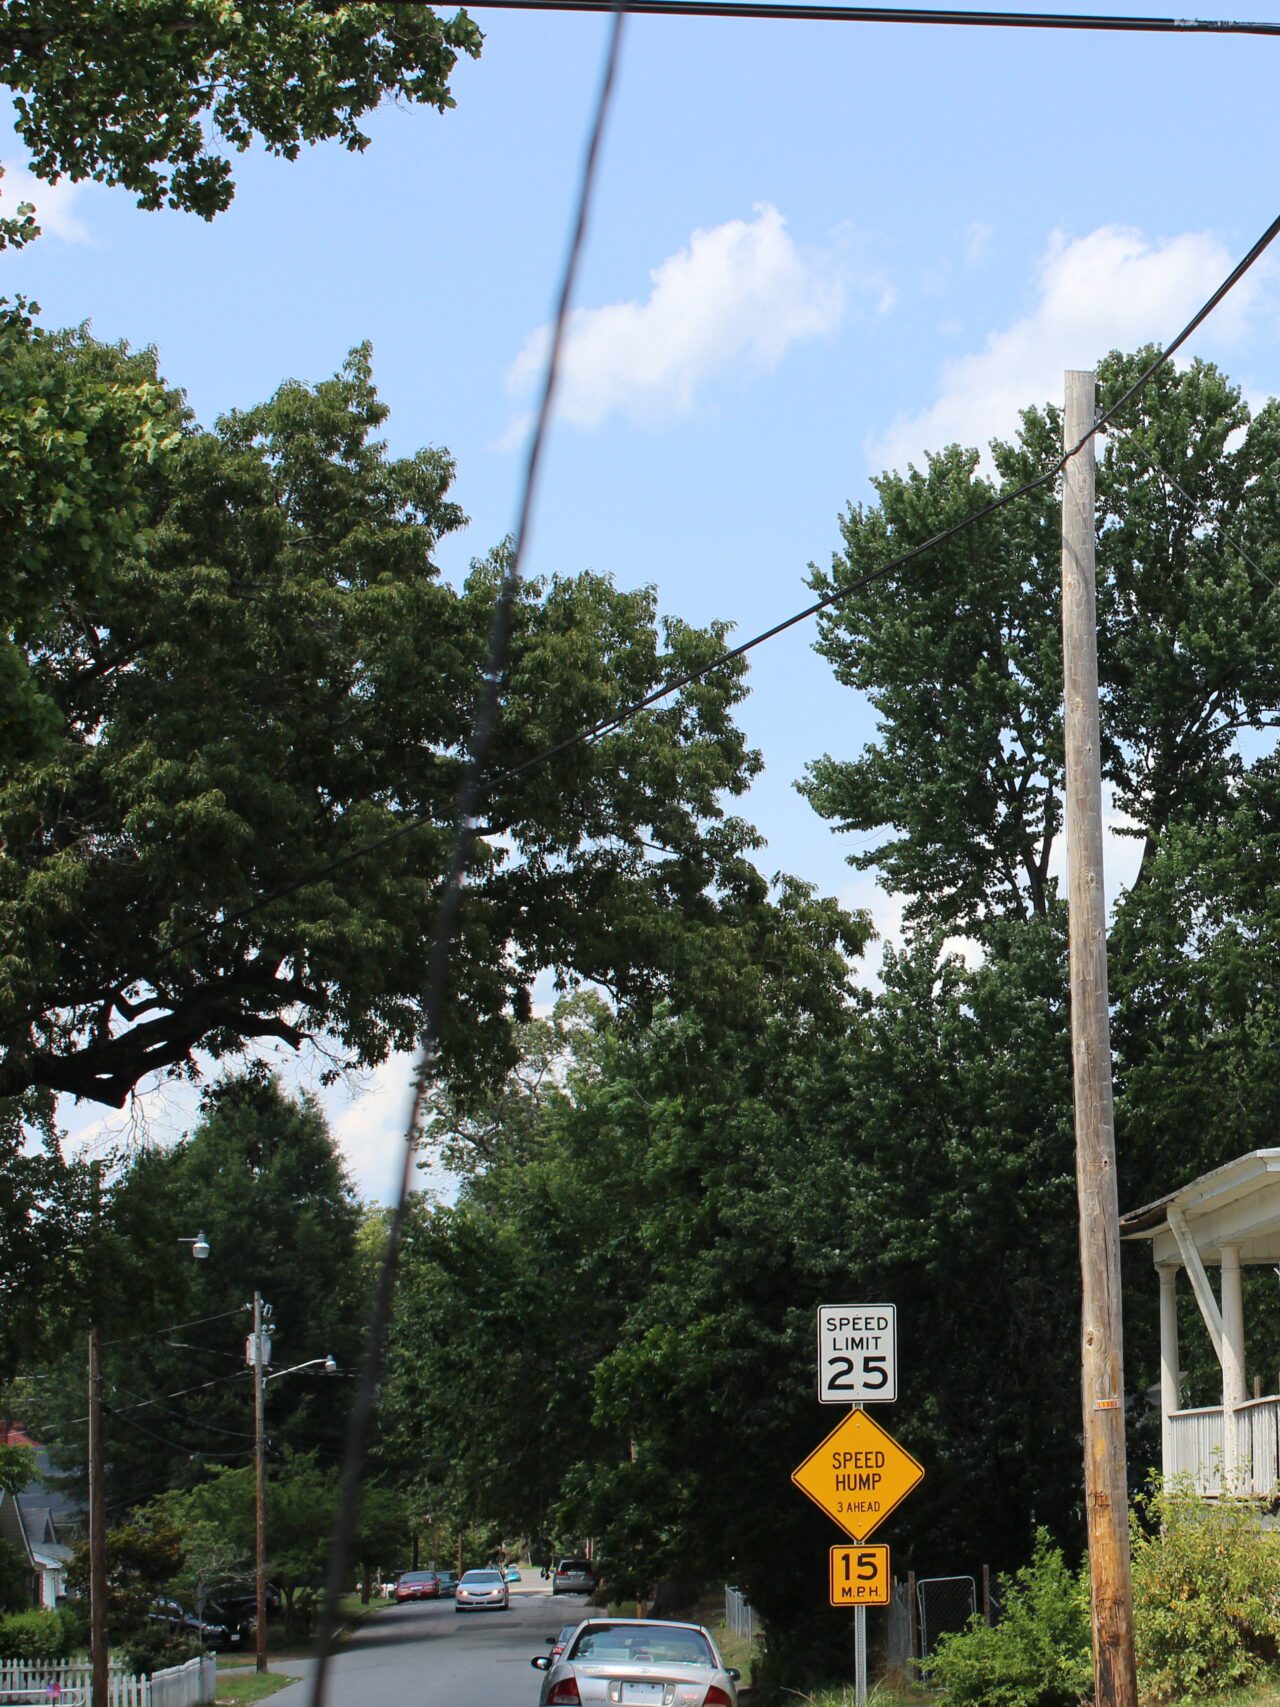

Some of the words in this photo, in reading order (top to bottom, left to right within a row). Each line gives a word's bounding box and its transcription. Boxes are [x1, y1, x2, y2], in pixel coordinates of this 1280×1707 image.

[826, 1316, 889, 1332] SPEED
[832, 1336, 882, 1351] LIMIT
[827, 1356, 889, 1391] 25
[832, 1451, 885, 1470] SPEED
[835, 1473, 882, 1492] HUMP
[836, 1501, 844, 1513] 3
[846, 1501, 881, 1513] AHEAD
[841, 1552, 878, 1581] 15
